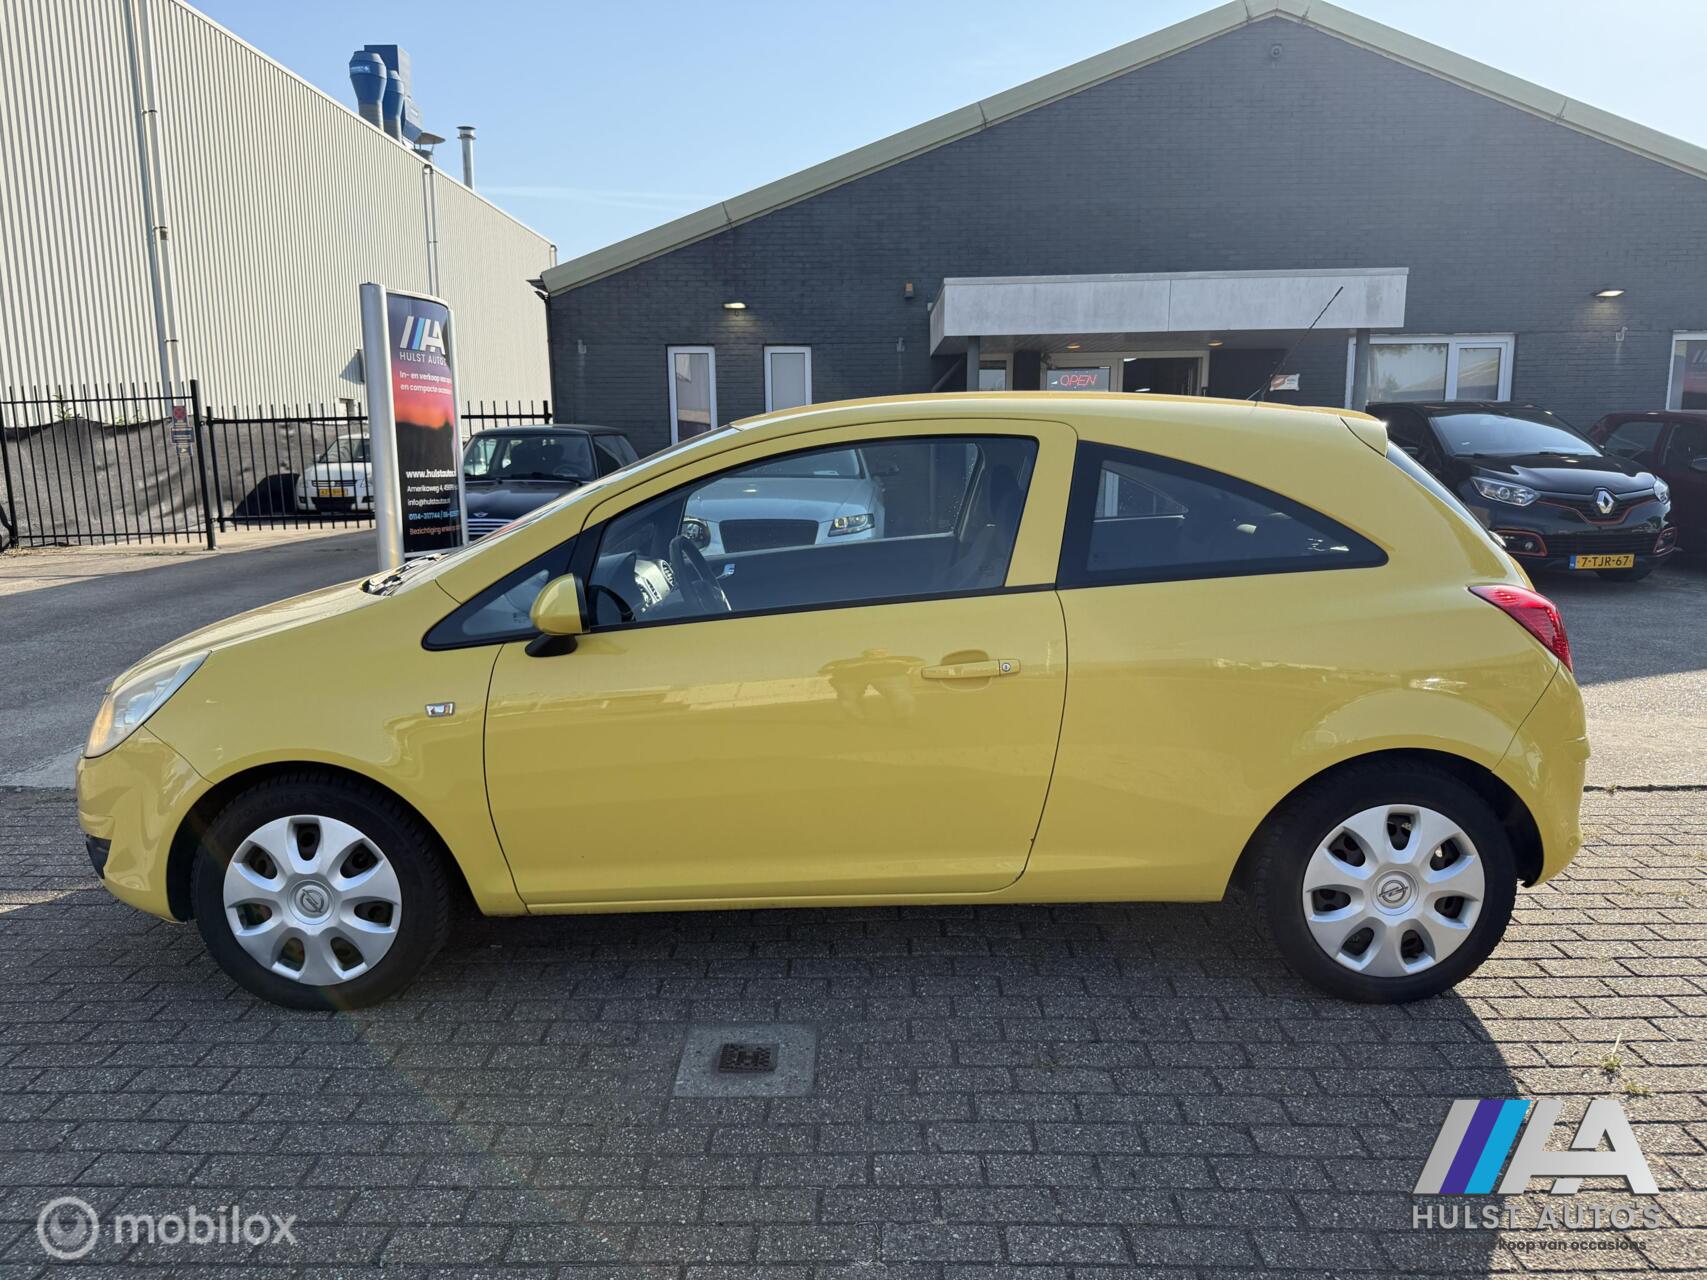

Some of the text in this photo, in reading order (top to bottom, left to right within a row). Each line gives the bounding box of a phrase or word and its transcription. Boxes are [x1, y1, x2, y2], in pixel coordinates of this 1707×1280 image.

[400, 351, 425, 363] HULST
[1060, 374, 1098, 386] OPEN
[1581, 555, 1630, 567] 7-TJR-67
